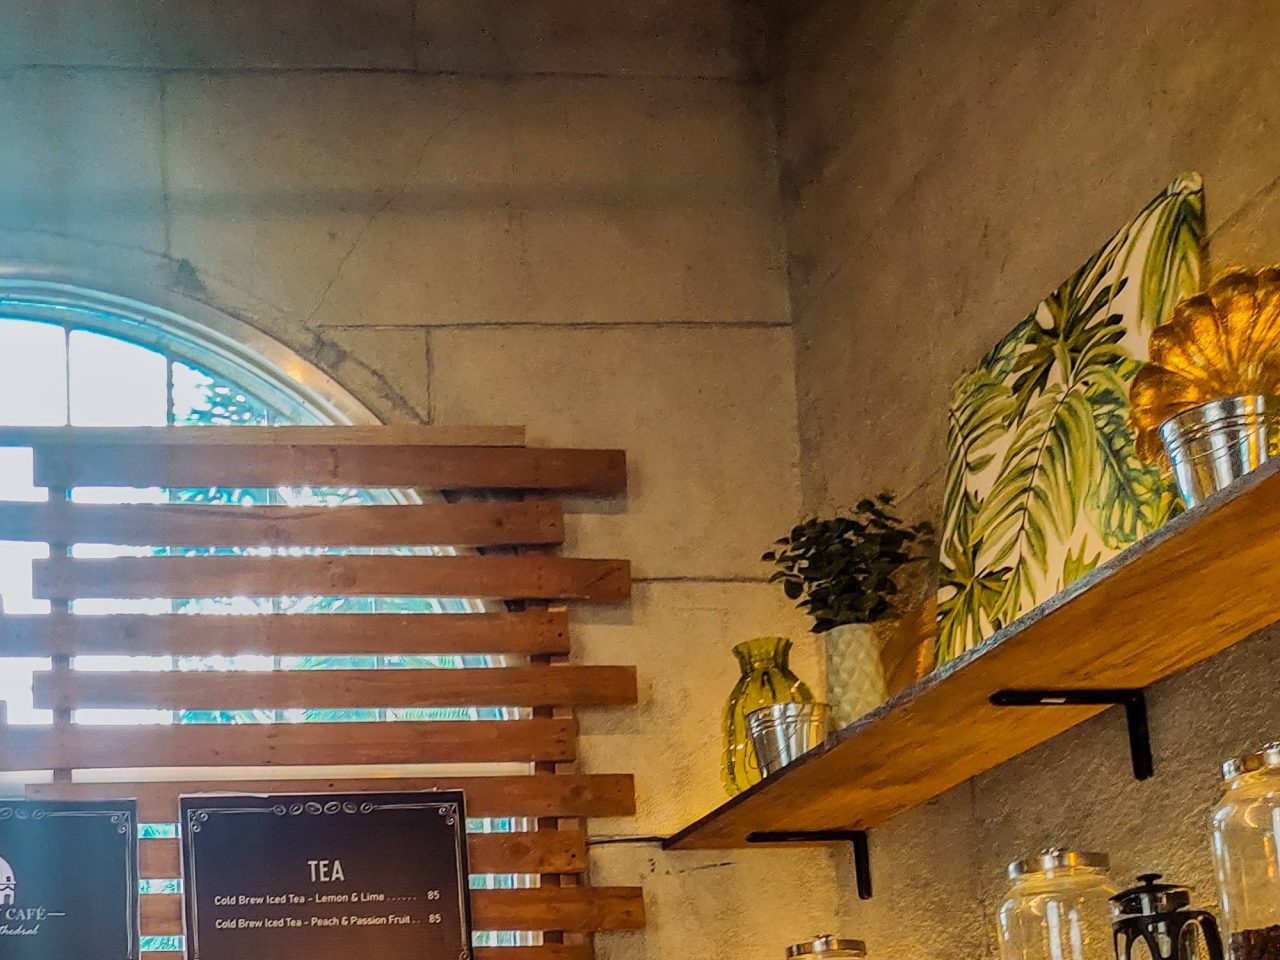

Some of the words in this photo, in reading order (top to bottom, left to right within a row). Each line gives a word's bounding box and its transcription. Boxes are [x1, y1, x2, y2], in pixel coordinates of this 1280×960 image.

[307, 860, 345, 882] TEA
[214, 894, 237, 906] Cold
[238, 894, 264, 905] Brew
[266, 894, 287, 905] Iced
[288, 894, 305, 904] Tea
[315, 893, 349, 903] Lemon
[350, 892, 359, 902] &
[360, 892, 385, 902] Lime
[427, 890, 440, 900] 85
[5, 904, 46, 921] CAFÉ
[215, 918, 237, 930] Cold
[238, 918, 263, 929] Brew
[264, 917, 285, 929] Iced
[285, 917, 302, 928] Tea
[310, 916, 339, 927] Peach
[340, 915, 349, 926] &
[350, 915, 387, 926] Passion
[388, 914, 411, 925] Fruit
[428, 914, 442, 924] 85
